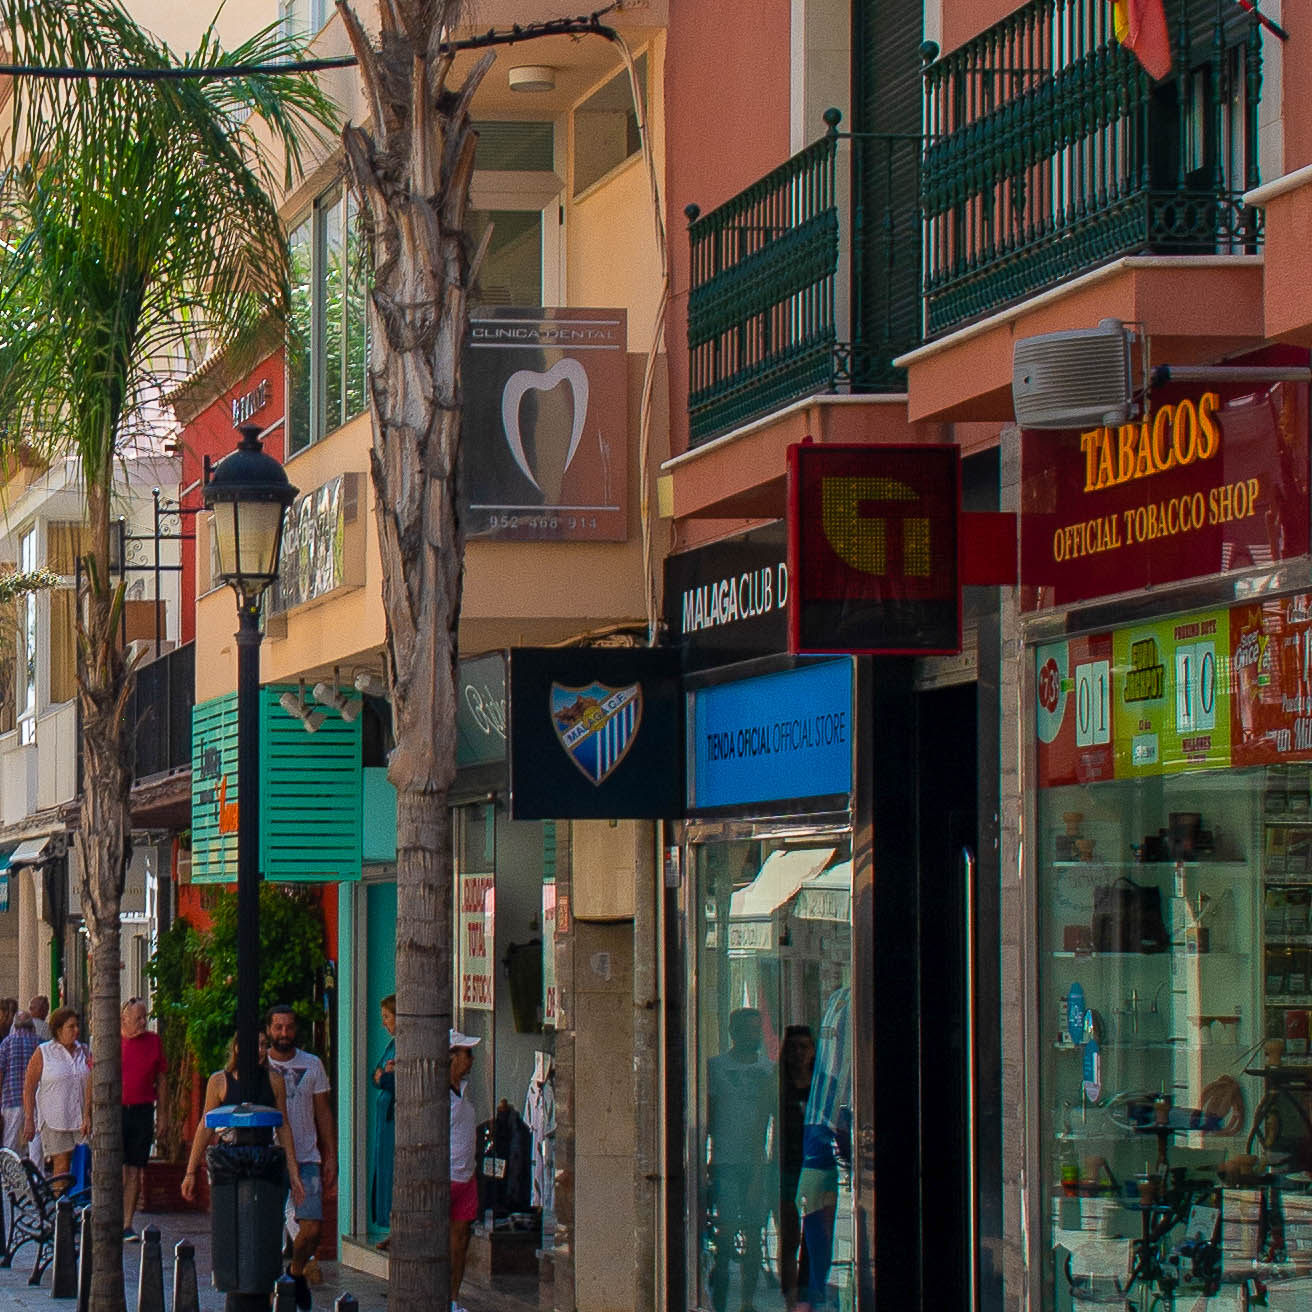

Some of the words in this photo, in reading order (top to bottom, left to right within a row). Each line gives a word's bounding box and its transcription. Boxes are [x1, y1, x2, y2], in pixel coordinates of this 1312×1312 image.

[544, 329, 612, 339] DENTAL
[1080, 392, 1220, 492] TABACOS
[489, 516, 518, 528] 952
[568, 517, 597, 528] 914
[1053, 514, 1121, 562] OFFICIAL
[1124, 492, 1205, 545] TOBACCO
[1209, 478, 1259, 525] SHOP
[682, 576, 738, 634] MALAGA
[739, 566, 772, 619] CLUB
[738, 725, 771, 758] OFICIAL
[773, 719, 813, 753] OFFICIAL
[815, 711, 846, 745] STORE
